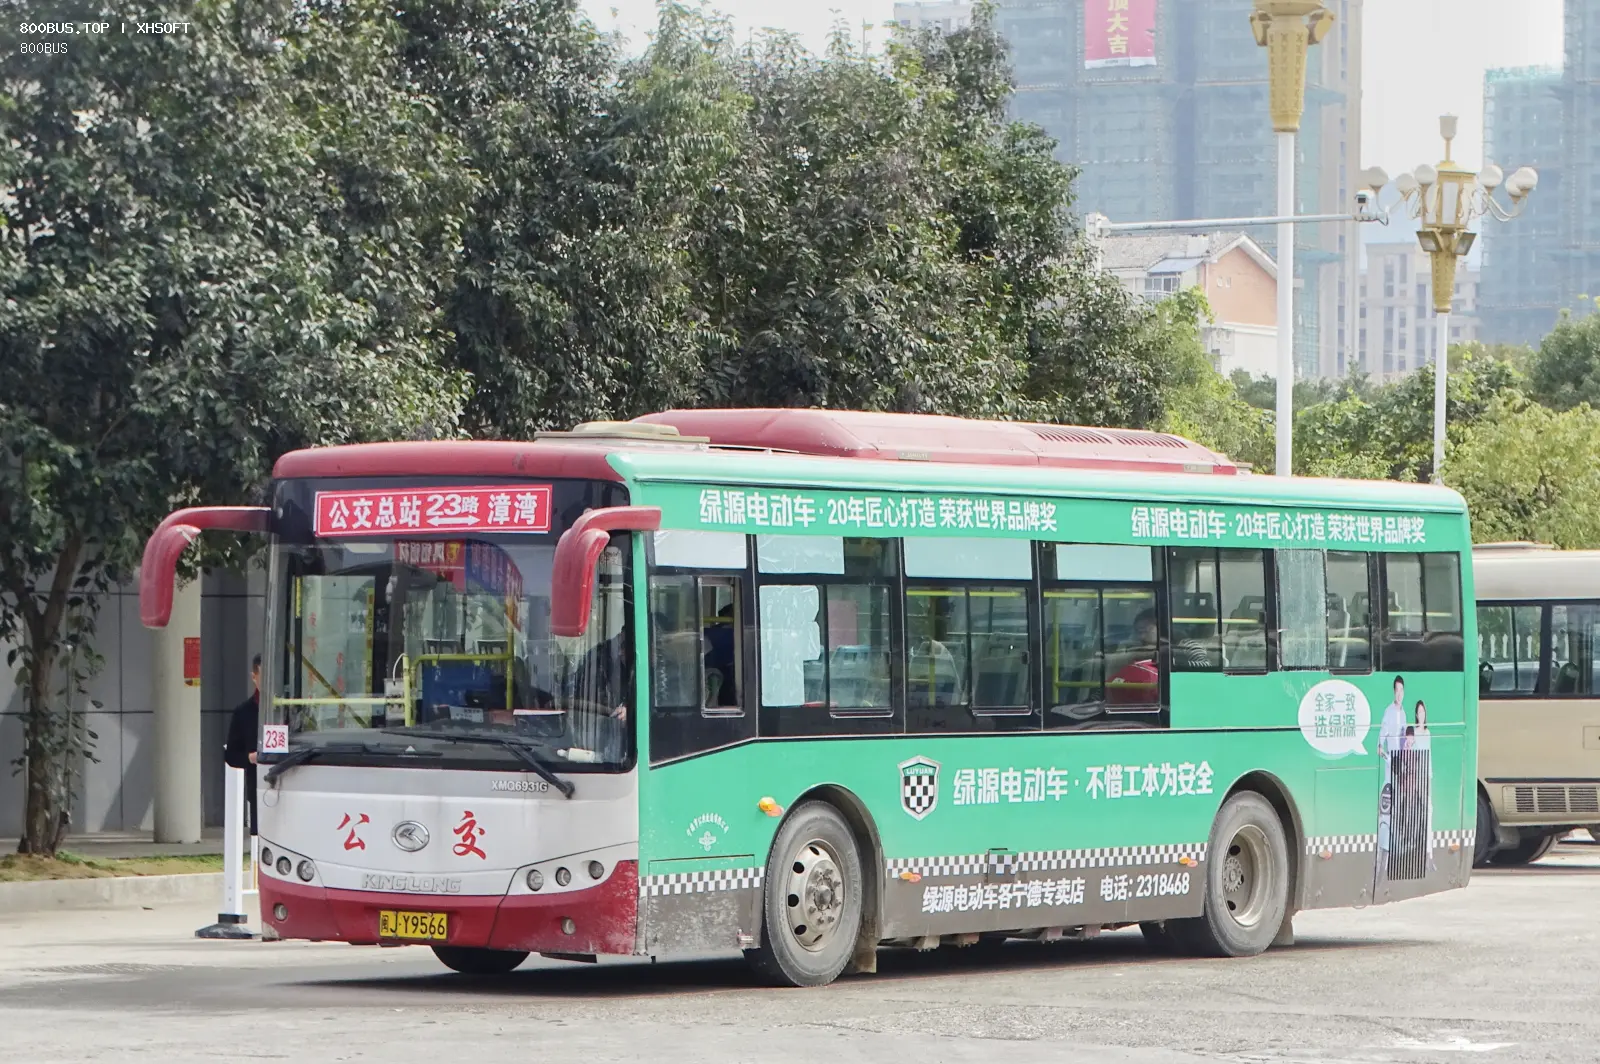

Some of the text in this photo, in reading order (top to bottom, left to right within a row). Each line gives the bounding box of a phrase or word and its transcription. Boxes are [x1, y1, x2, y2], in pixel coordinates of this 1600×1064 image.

[328, 492, 538, 530] 公交总站 23路 漳湾
[1314, 692, 1356, 712] 全家一致
[1314, 714, 1356, 738] 选绿源
[491, 780, 549, 793] XMQ6931G
